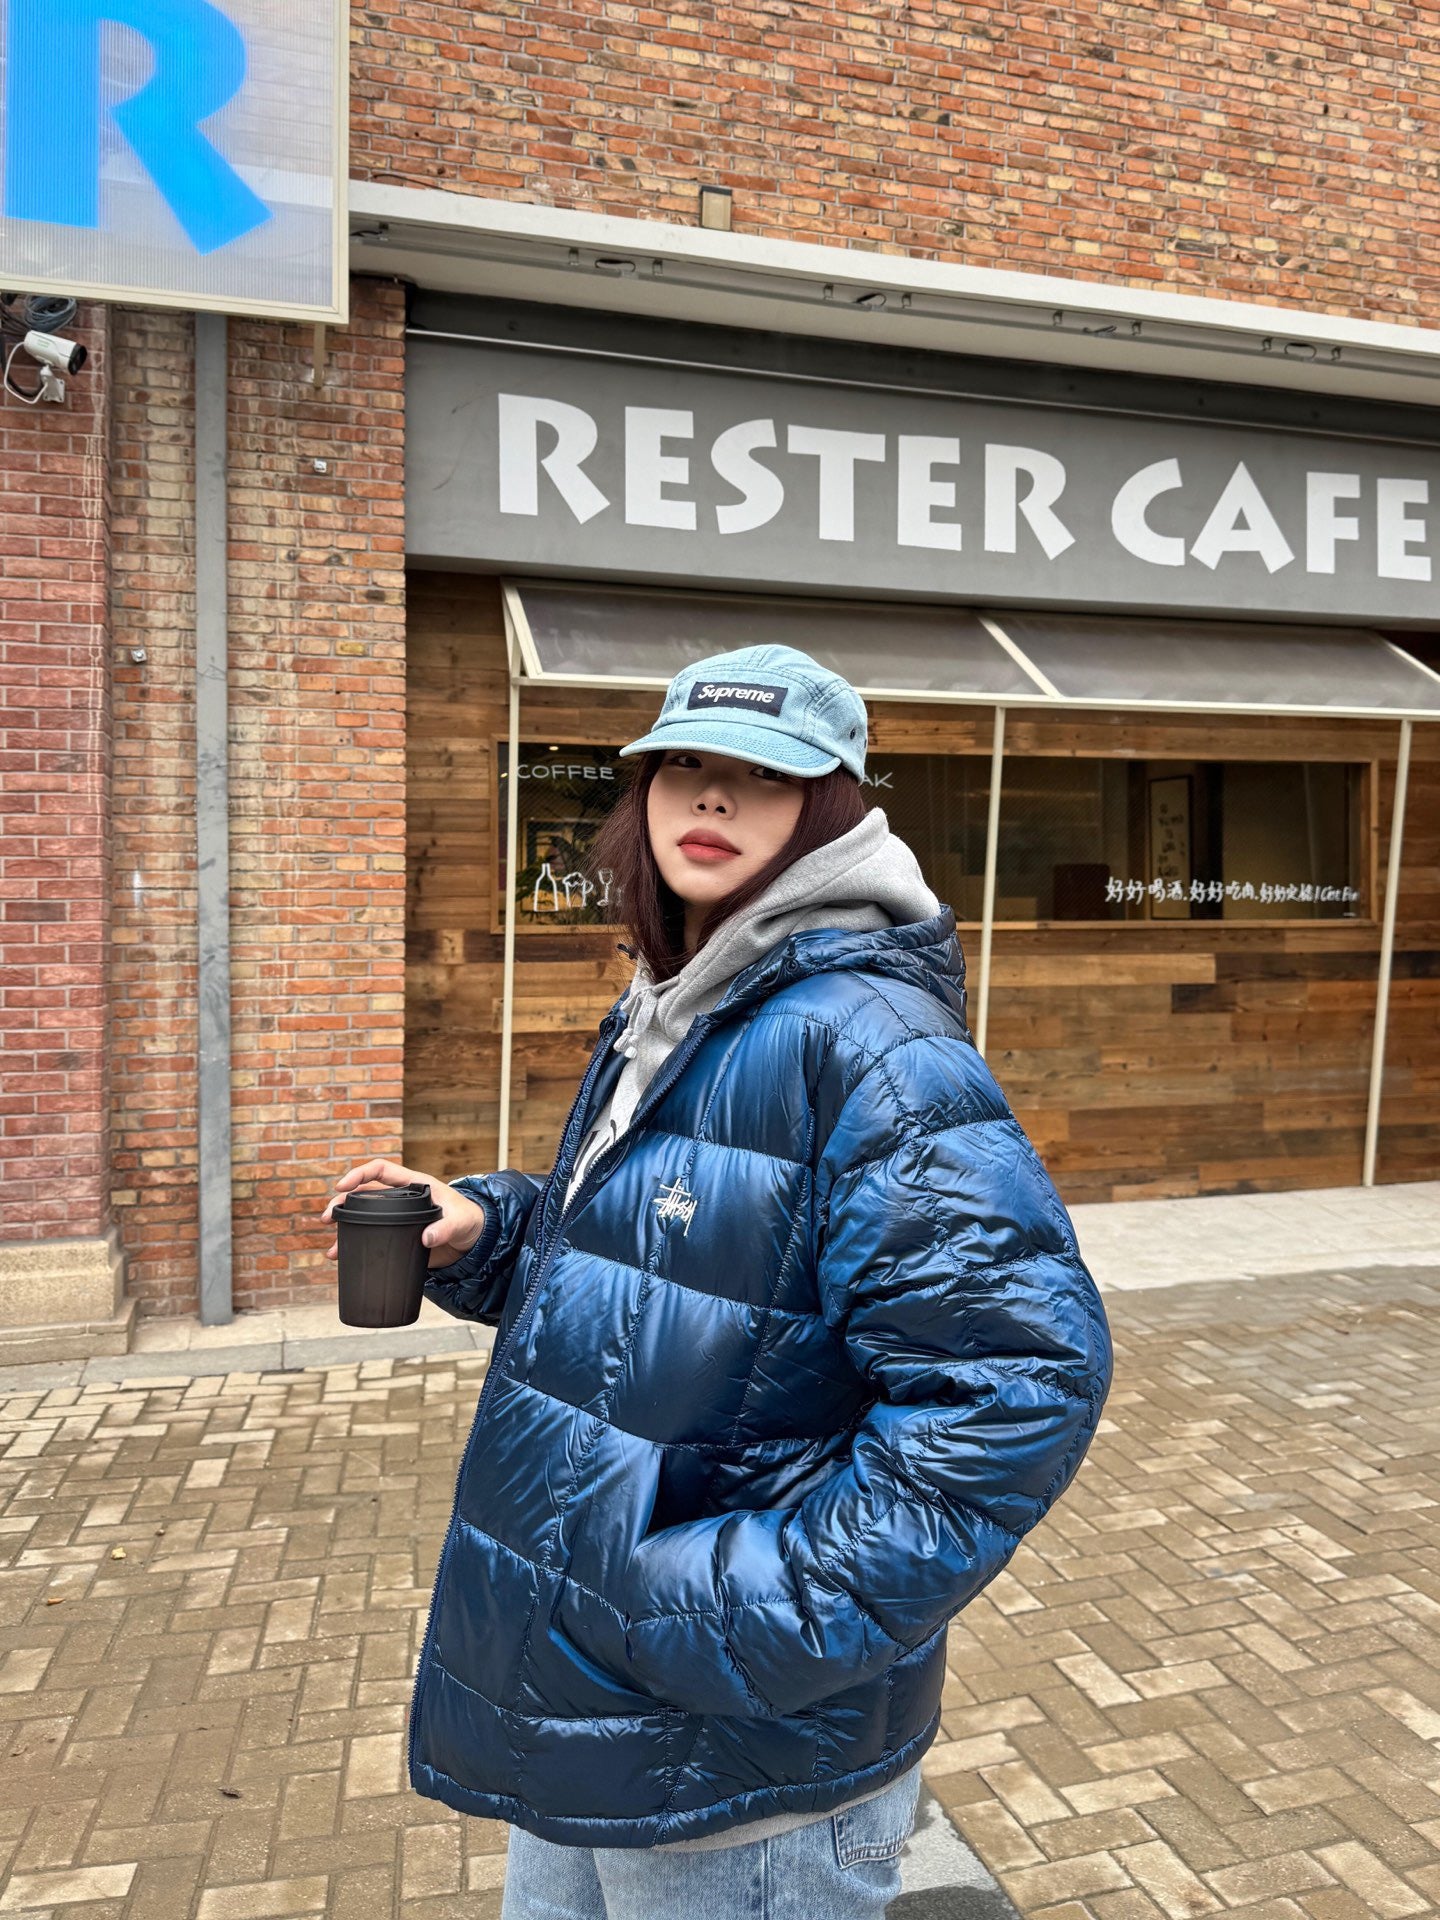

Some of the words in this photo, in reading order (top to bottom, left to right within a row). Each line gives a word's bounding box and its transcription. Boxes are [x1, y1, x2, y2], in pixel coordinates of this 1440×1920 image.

[5, 0, 273, 256] R
[498, 392, 1075, 560] RESTER
[1111, 457, 1433, 582] CAFE
[698, 684, 775, 703] Supreme
[517, 764, 615, 780] COFFEE
